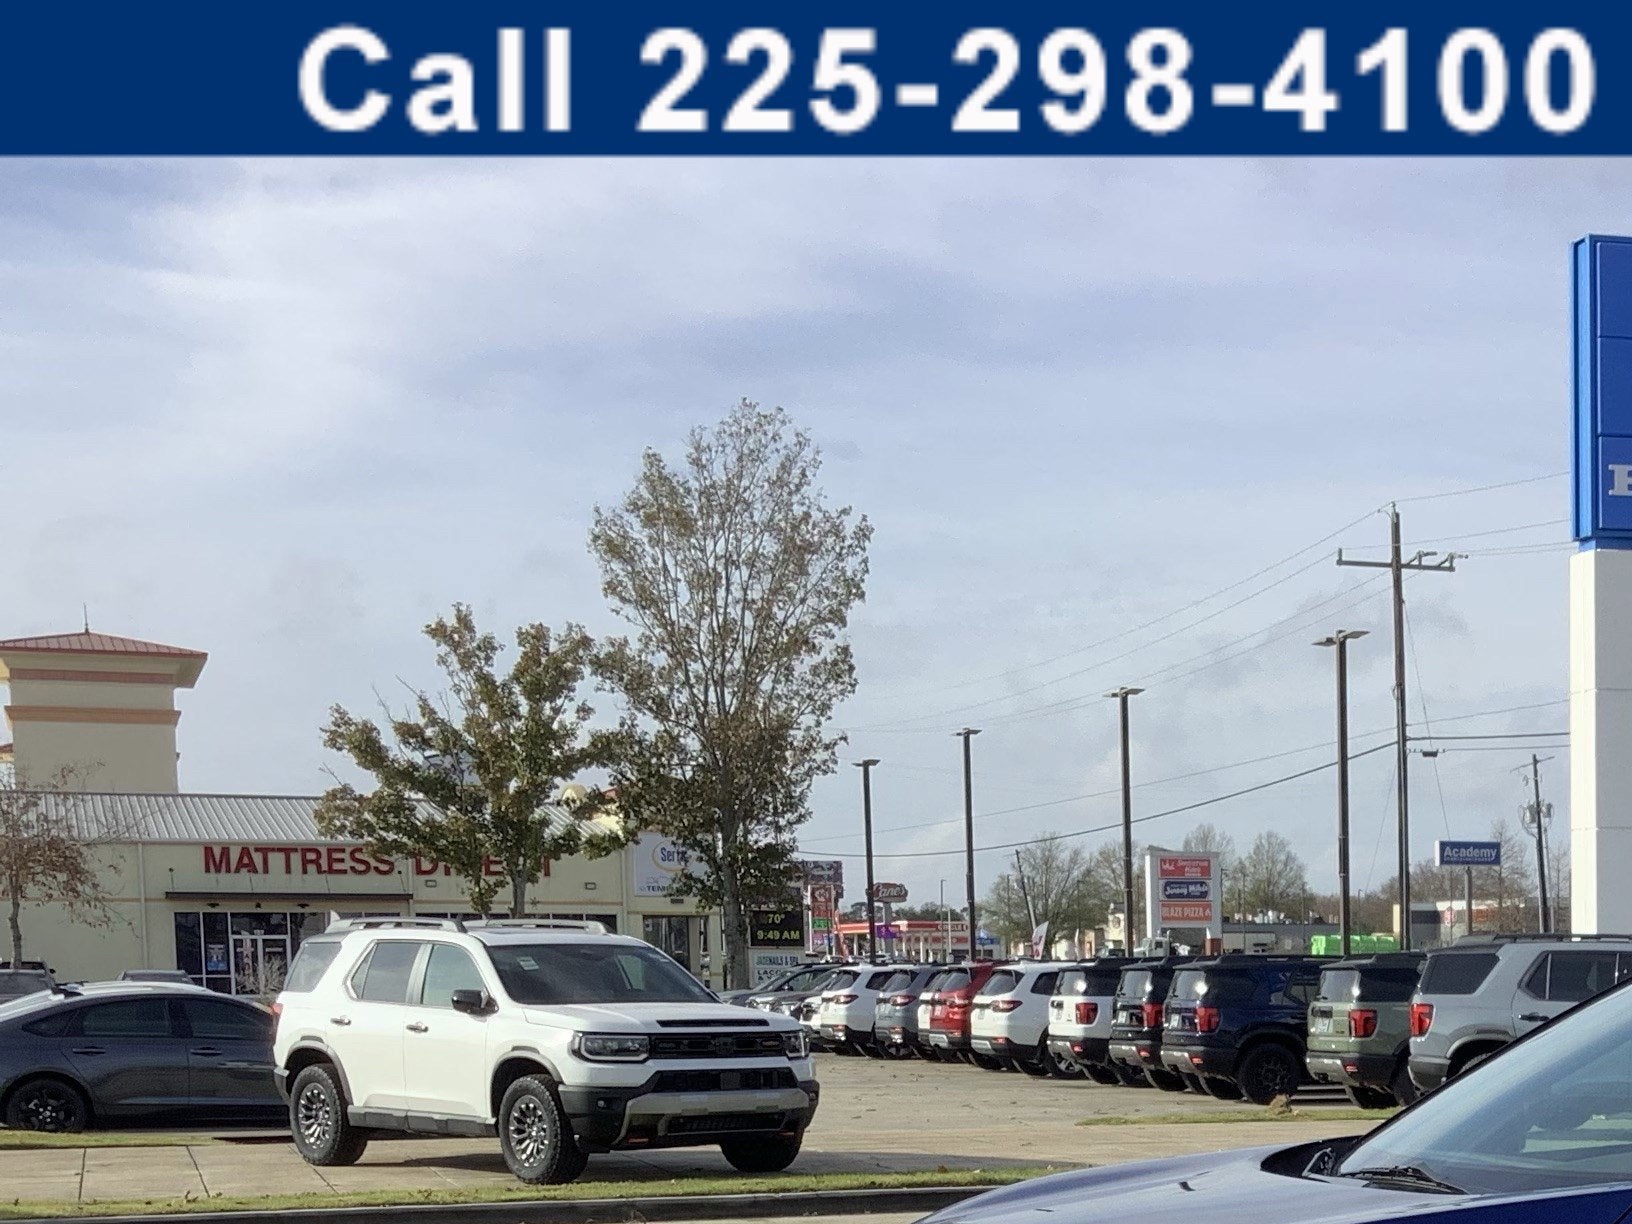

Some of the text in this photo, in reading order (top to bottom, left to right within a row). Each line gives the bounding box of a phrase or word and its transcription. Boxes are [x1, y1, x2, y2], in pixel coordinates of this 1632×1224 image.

[1443, 846, 1497, 861] Academy
[203, 846, 550, 876] MATTRESS DET
[1183, 907, 1204, 917] PIZZA
[757, 930, 800, 940] 9:49 AM
